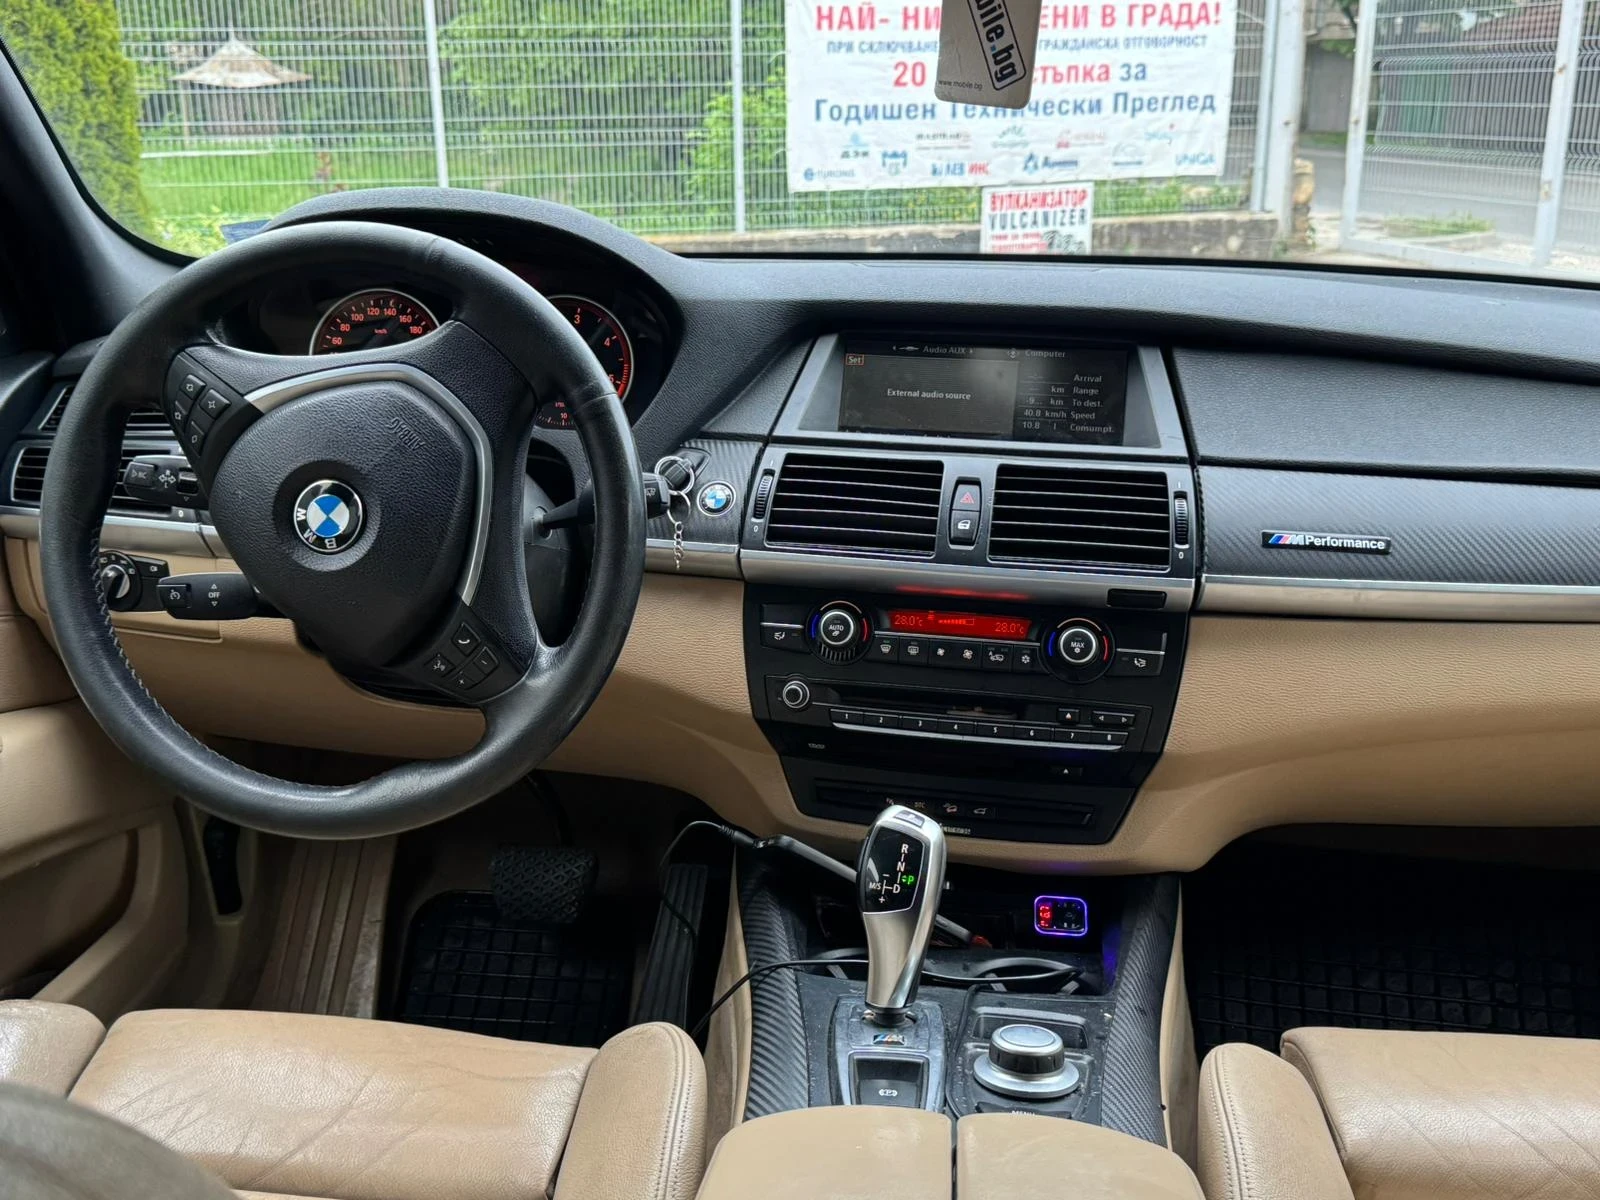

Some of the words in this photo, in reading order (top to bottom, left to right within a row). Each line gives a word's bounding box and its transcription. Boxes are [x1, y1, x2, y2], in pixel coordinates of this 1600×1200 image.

[1101, 4, 1116, 28] В
[1127, 2, 1222, 31] ГРАДА!
[893, 61, 926, 88] 20
[1119, 62, 1147, 81] за
[814, 98, 937, 126] Годишен
[1113, 92, 1217, 118] Преглед
[988, 208, 1087, 231] VULCANIZER
[367, 308, 380, 316] 120
[384, 308, 397, 316] 140
[351, 313, 365, 322] 100
[399, 315, 412, 323] 160
[573, 315, 581, 325] 3
[340, 323, 351, 332] 80
[409, 326, 423, 334] 180
[332, 337, 343, 345] 60
[604, 337, 611, 347] 4
[1024, 349, 1066, 359] Computer
[1073, 373, 1103, 383] Arrival
[887, 388, 920, 398] External
[920, 389, 944, 399] audio
[945, 392, 972, 400] source
[1051, 385, 1065, 394] km
[1073, 386, 1100, 396] Range
[1050, 397, 1064, 406] km
[1072, 399, 1082, 407] To
[1045, 410, 1067, 418] km/h
[1070, 410, 1096, 420] Speed
[1305, 535, 1386, 550] Performance
[207, 591, 221, 599] OFF
[828, 624, 845, 632] AUTO
[1070, 641, 1085, 649] MAX
[1029, 729, 1035, 737] 6
[901, 843, 909, 854] R
[896, 861, 906, 872] N
[907, 875, 915, 886] P
[892, 883, 901, 894] D
